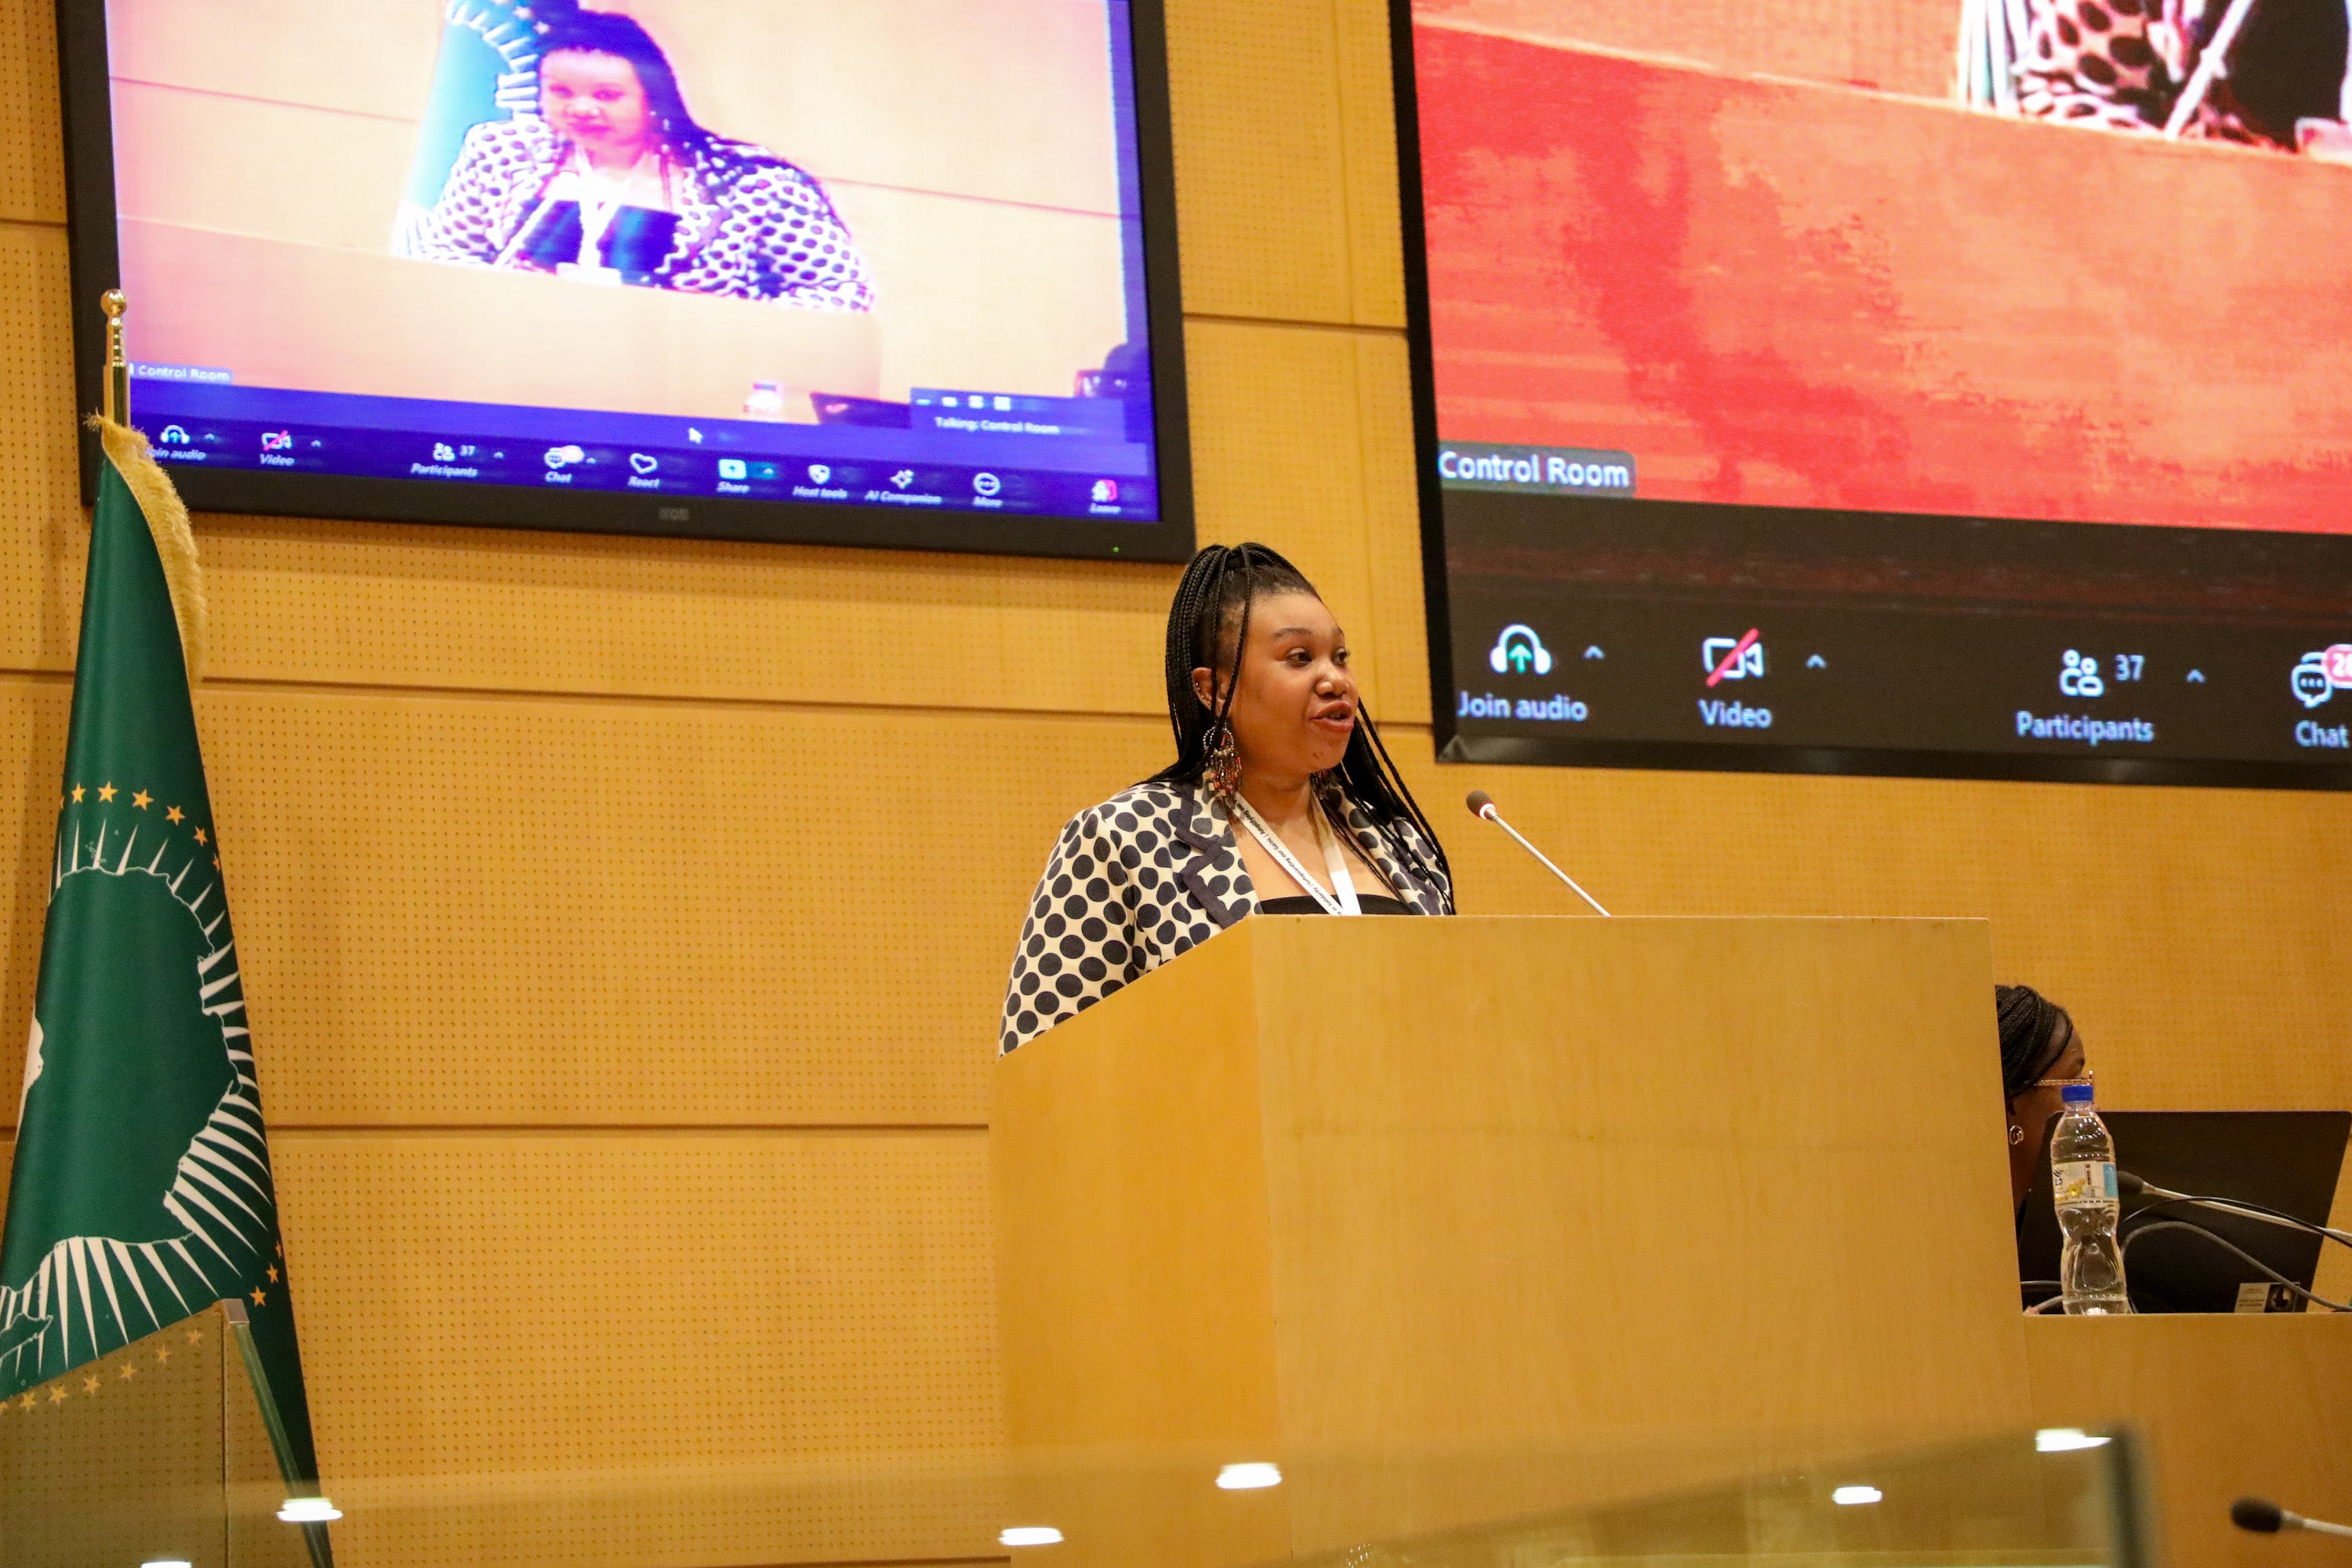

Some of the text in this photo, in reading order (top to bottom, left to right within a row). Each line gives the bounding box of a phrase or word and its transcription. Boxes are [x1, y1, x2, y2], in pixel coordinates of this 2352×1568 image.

[138, 364, 230, 381] Control Room
[170, 448, 207, 462] audio
[260, 453, 296, 467] Video
[411, 463, 478, 478] Participants
[545, 471, 573, 483] Chat
[1438, 450, 1631, 488] Control Room
[2115, 654, 2145, 682] 37
[1458, 691, 1588, 721] Join audio
[1698, 699, 1773, 728] Video
[2016, 710, 2155, 746] Participants
[2295, 720, 2350, 749] Chat
[1243, 810, 1265, 835] Amplifying
[1267, 837, 1279, 851] Gains
